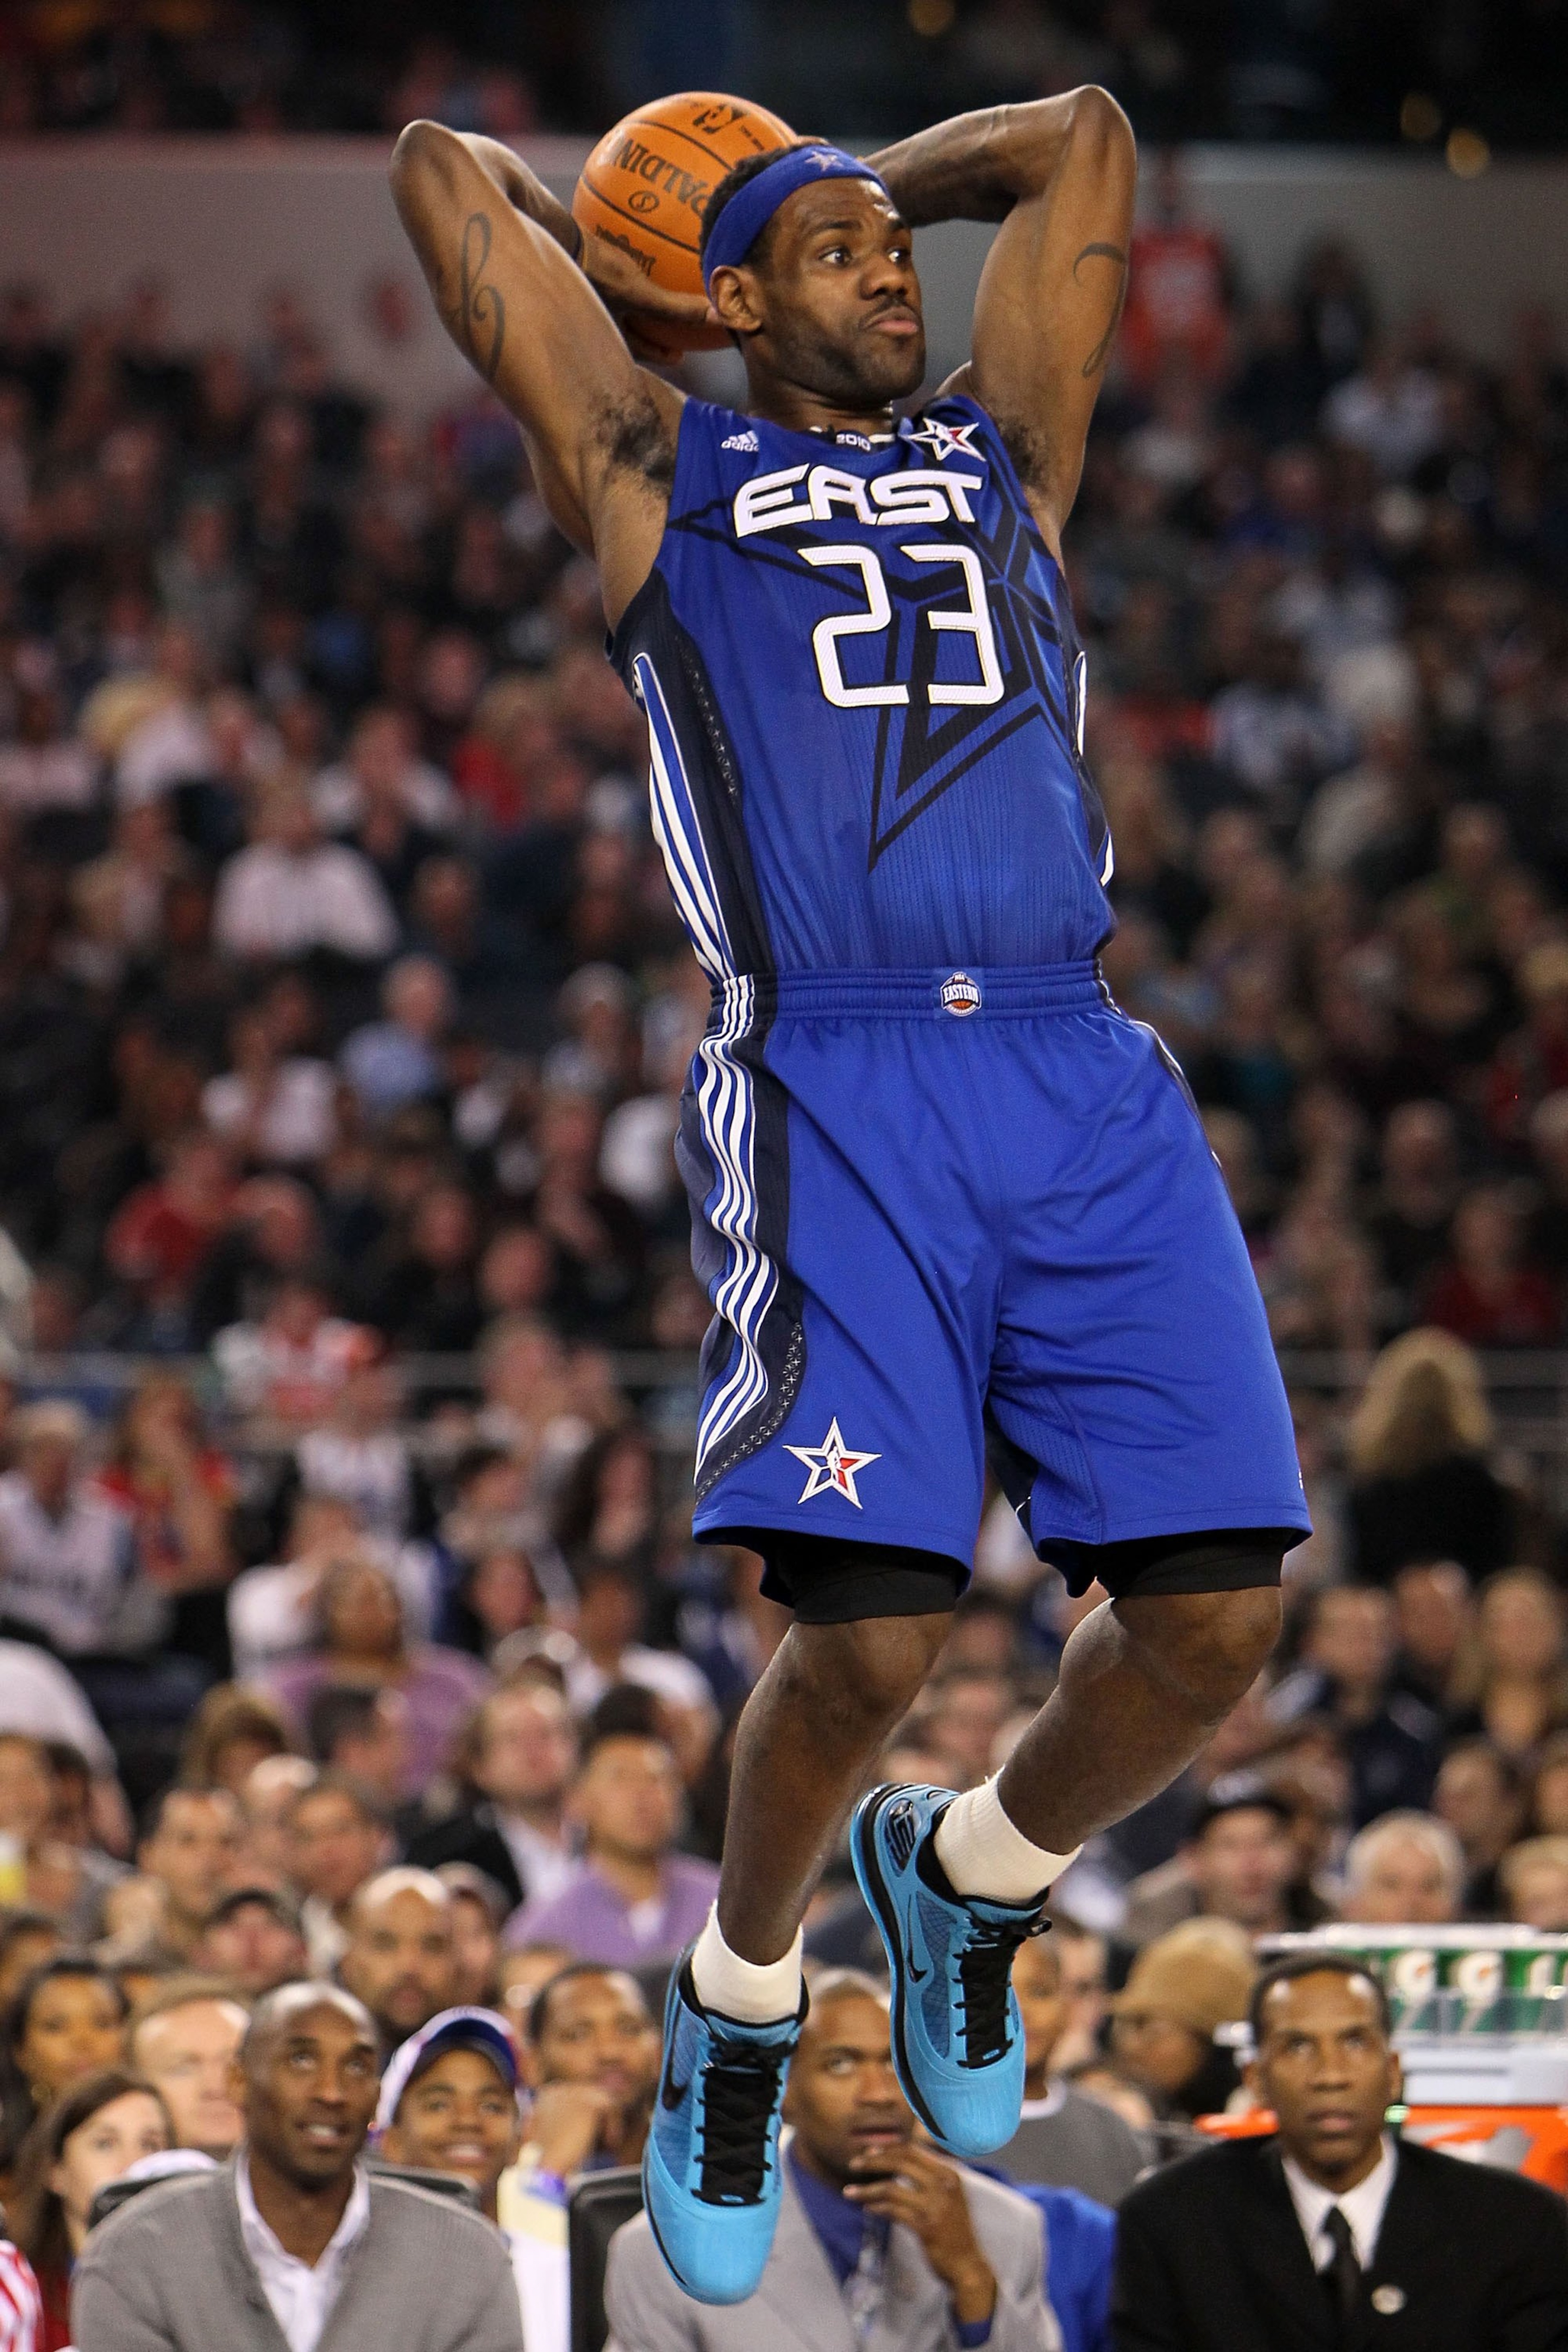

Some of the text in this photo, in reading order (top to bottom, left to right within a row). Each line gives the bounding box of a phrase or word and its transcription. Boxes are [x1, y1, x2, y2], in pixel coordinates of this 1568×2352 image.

[836, 434, 871, 451] 2010
[734, 463, 982, 538] EAST
[797, 545, 1004, 708] 23
[943, 984, 978, 1003] EASTERN
